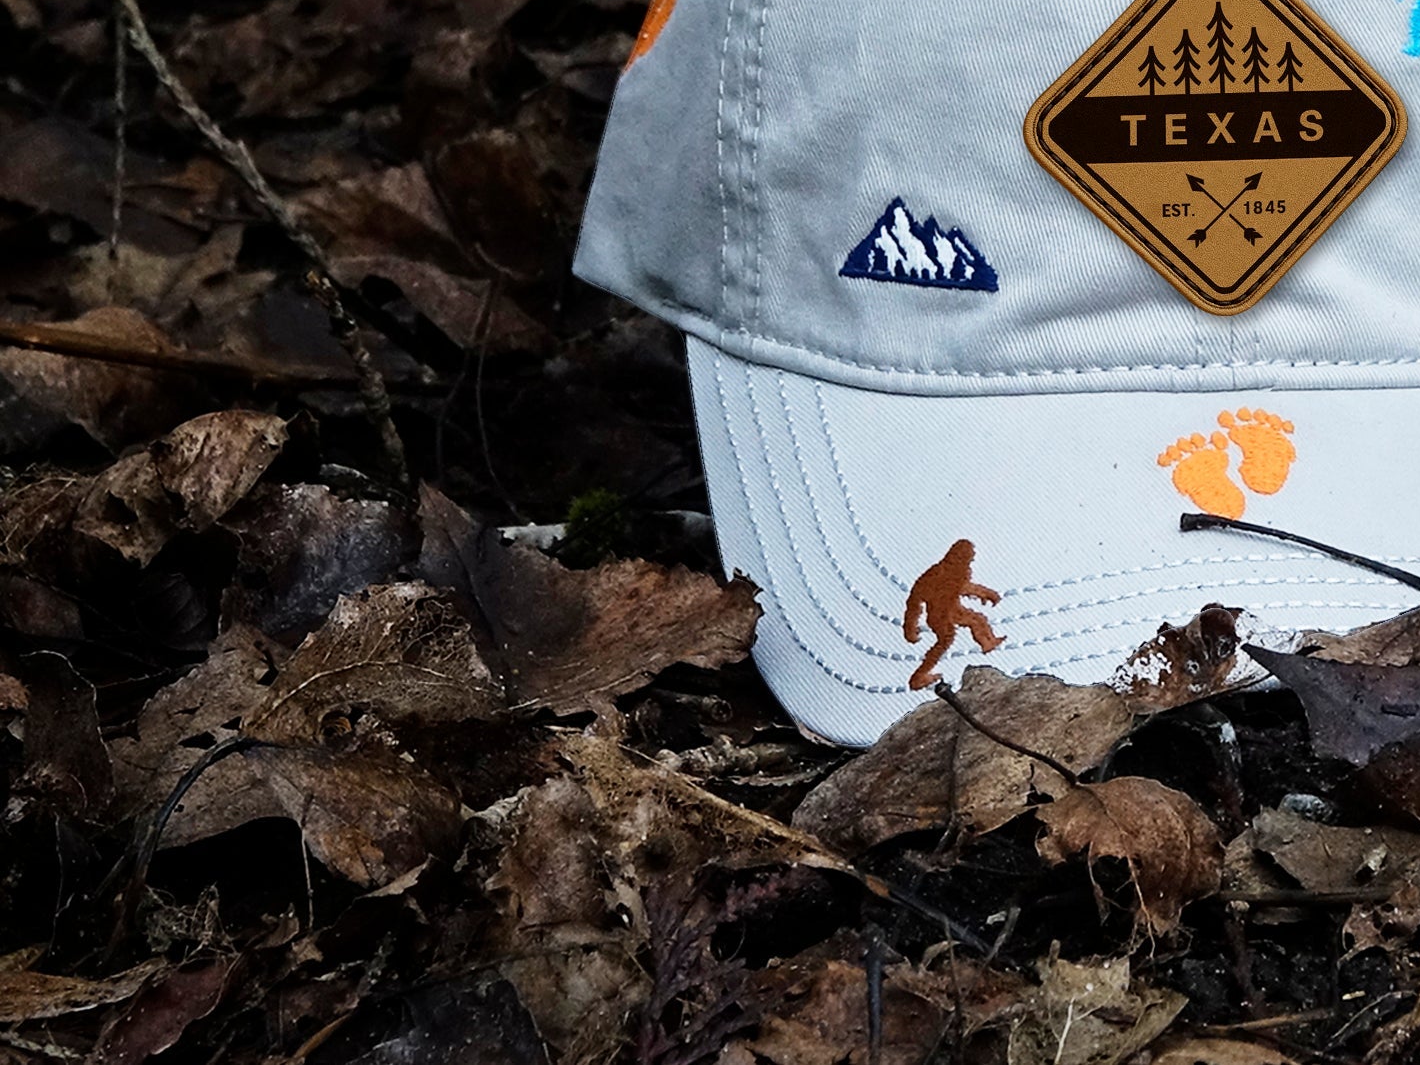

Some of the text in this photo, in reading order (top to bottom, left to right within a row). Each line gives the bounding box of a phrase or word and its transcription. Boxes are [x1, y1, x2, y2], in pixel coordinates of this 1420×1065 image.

[1120, 109, 1325, 147] TEXAS
[1162, 200, 1286, 218] EST. 1845
